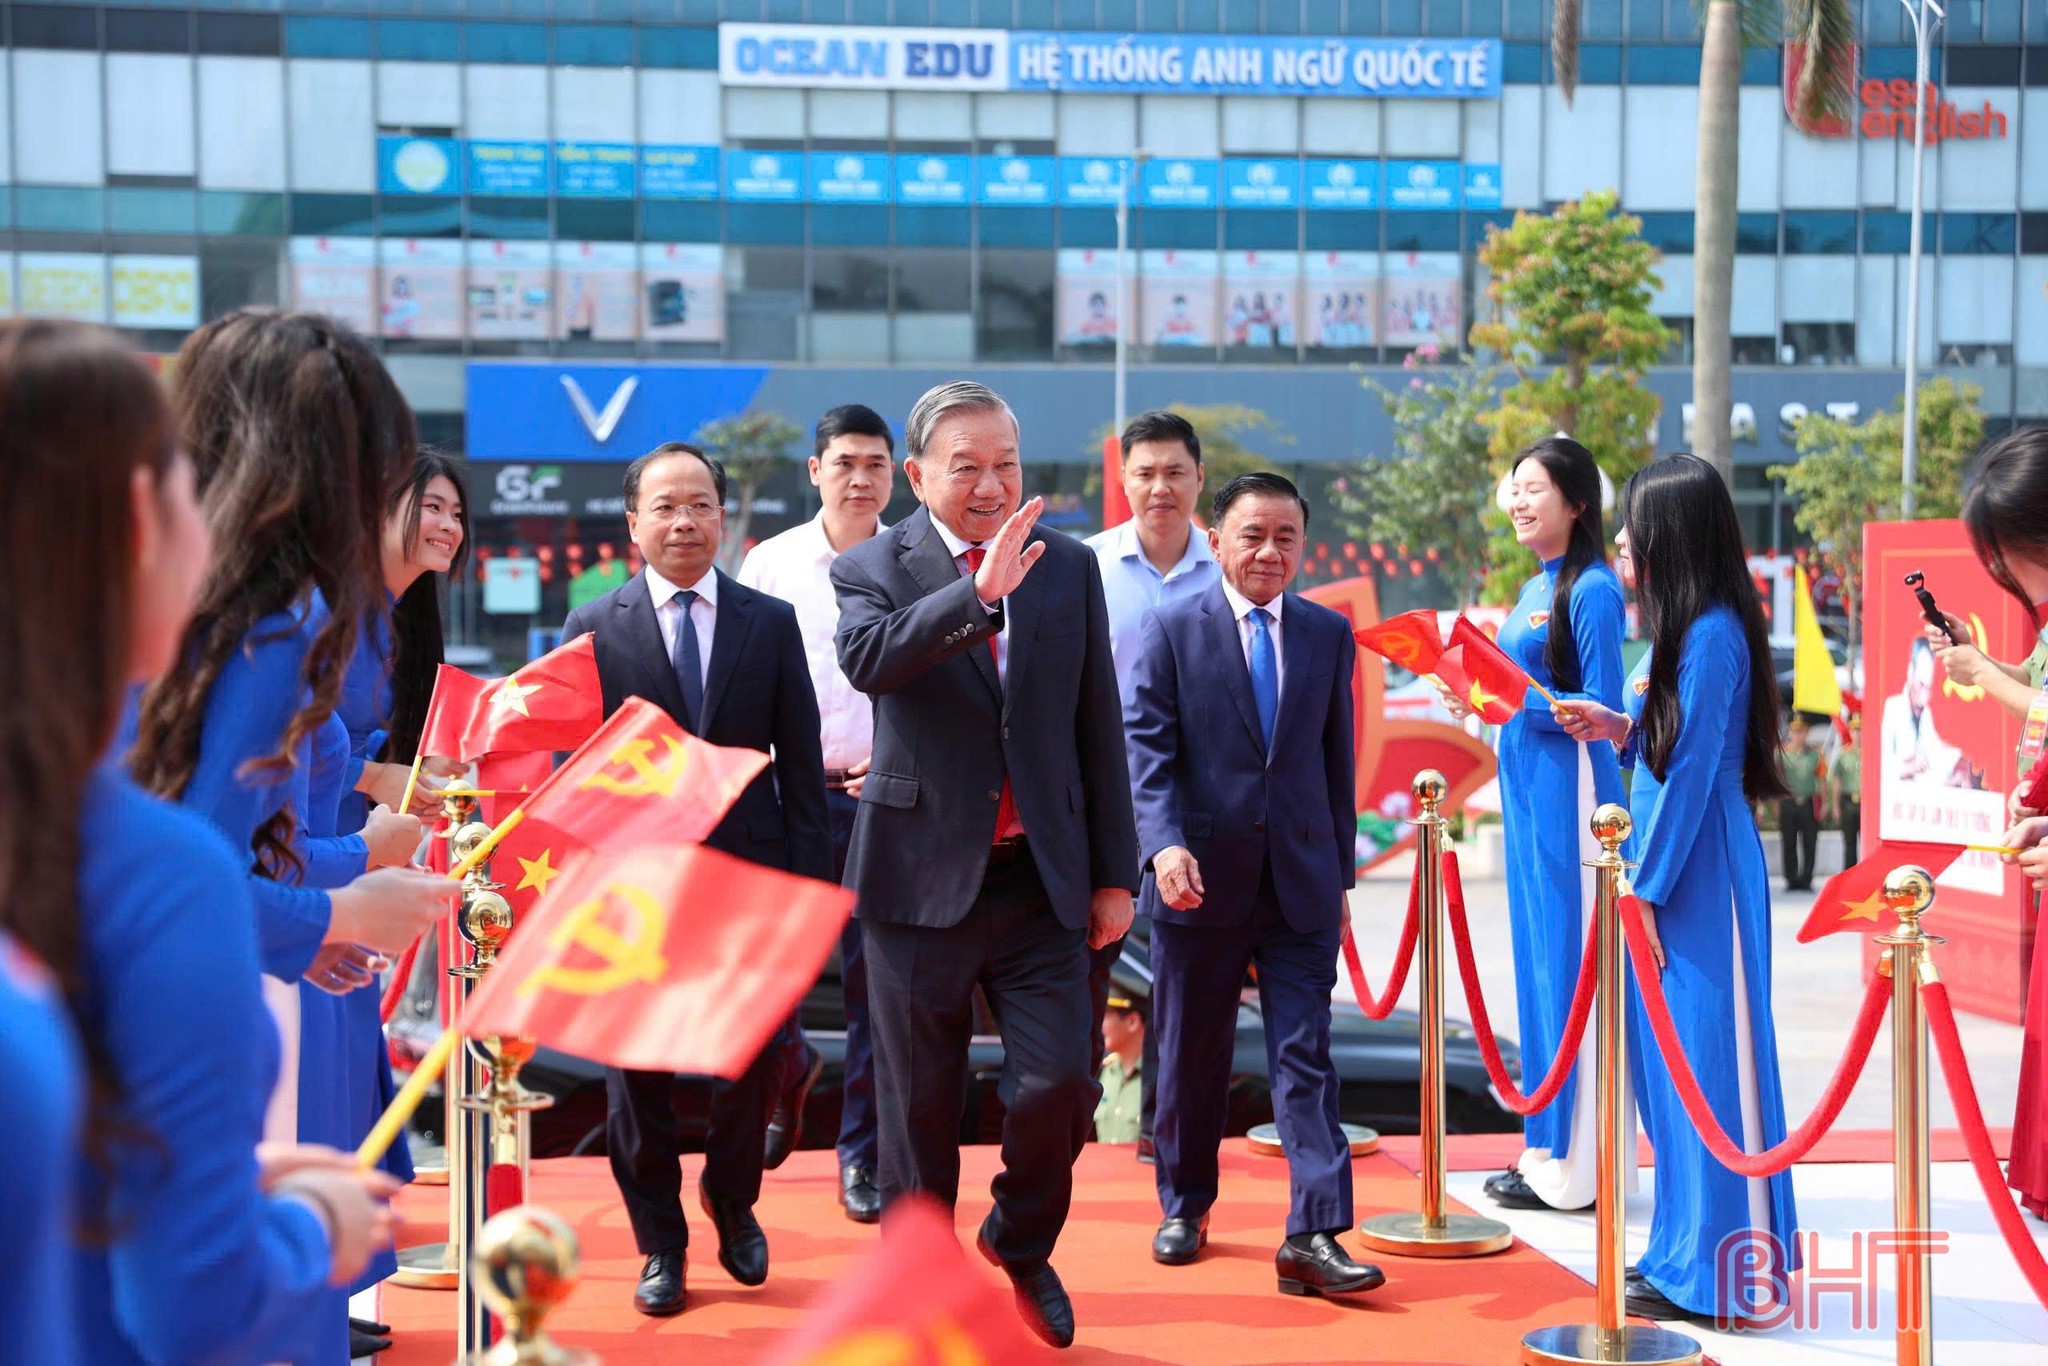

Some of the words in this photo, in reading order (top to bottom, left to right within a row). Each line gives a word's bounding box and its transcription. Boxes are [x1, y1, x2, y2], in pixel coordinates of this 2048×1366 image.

[735, 37, 890, 77] OCEAN
[904, 41, 994, 77] EDU
[1016, 36, 1063, 89] HỆ
[1066, 34, 1183, 85] THỐNG
[1191, 46, 1263, 85] ANH
[1272, 40, 1347, 87] NGỮ
[1352, 40, 1443, 90] QUỐC
[1449, 40, 1491, 88] TẾ
[1860, 99, 2008, 147] english
